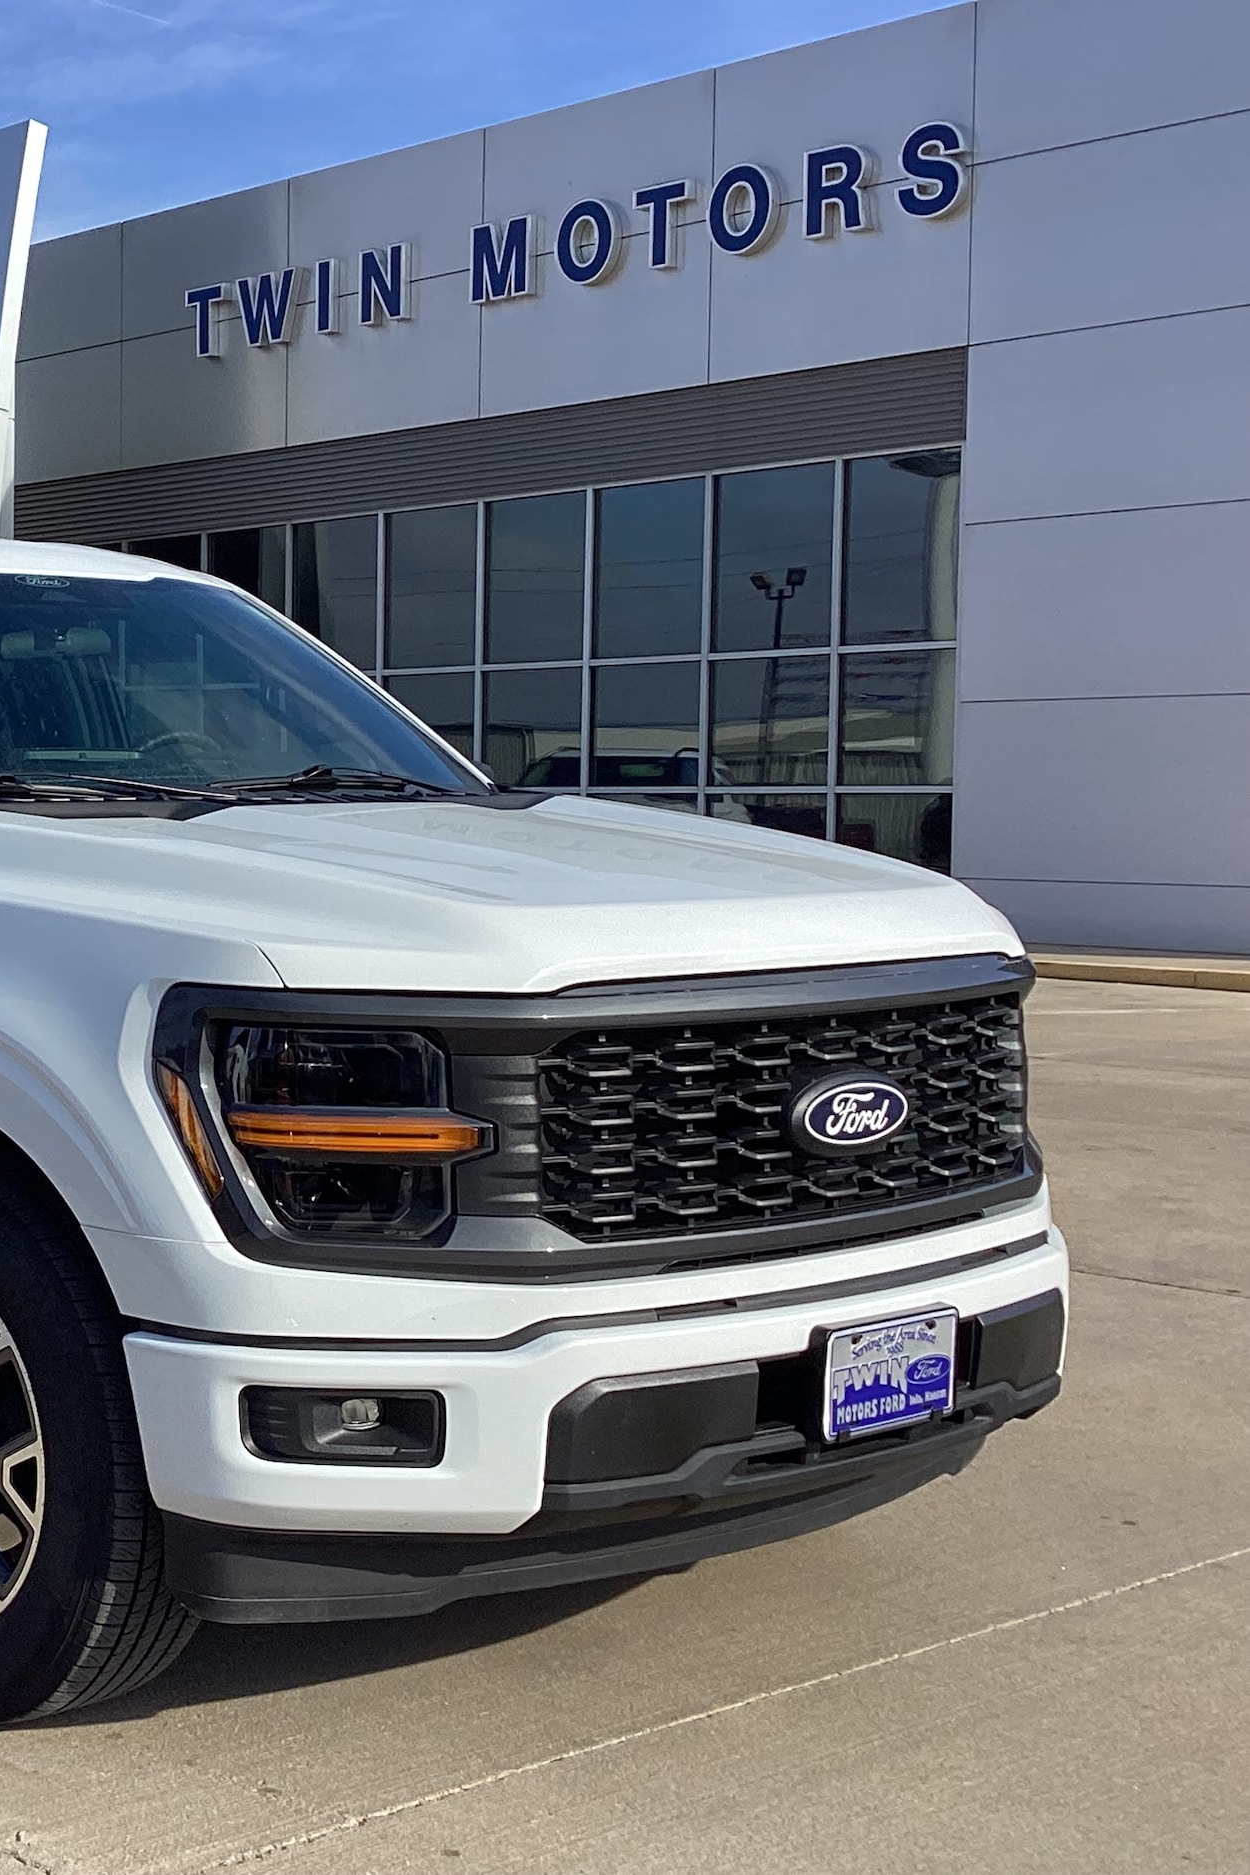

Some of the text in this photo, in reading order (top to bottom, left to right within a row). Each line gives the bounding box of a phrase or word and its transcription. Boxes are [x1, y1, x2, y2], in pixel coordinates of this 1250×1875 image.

[185, 120, 972, 358] TWIN MOTORS
[825, 1091, 891, 1136] Ford
[833, 1356, 910, 1405] TWIN
[913, 1359, 943, 1381] Ford
[836, 1399, 878, 1425] MOTORS
[879, 1393, 906, 1415] FORD
